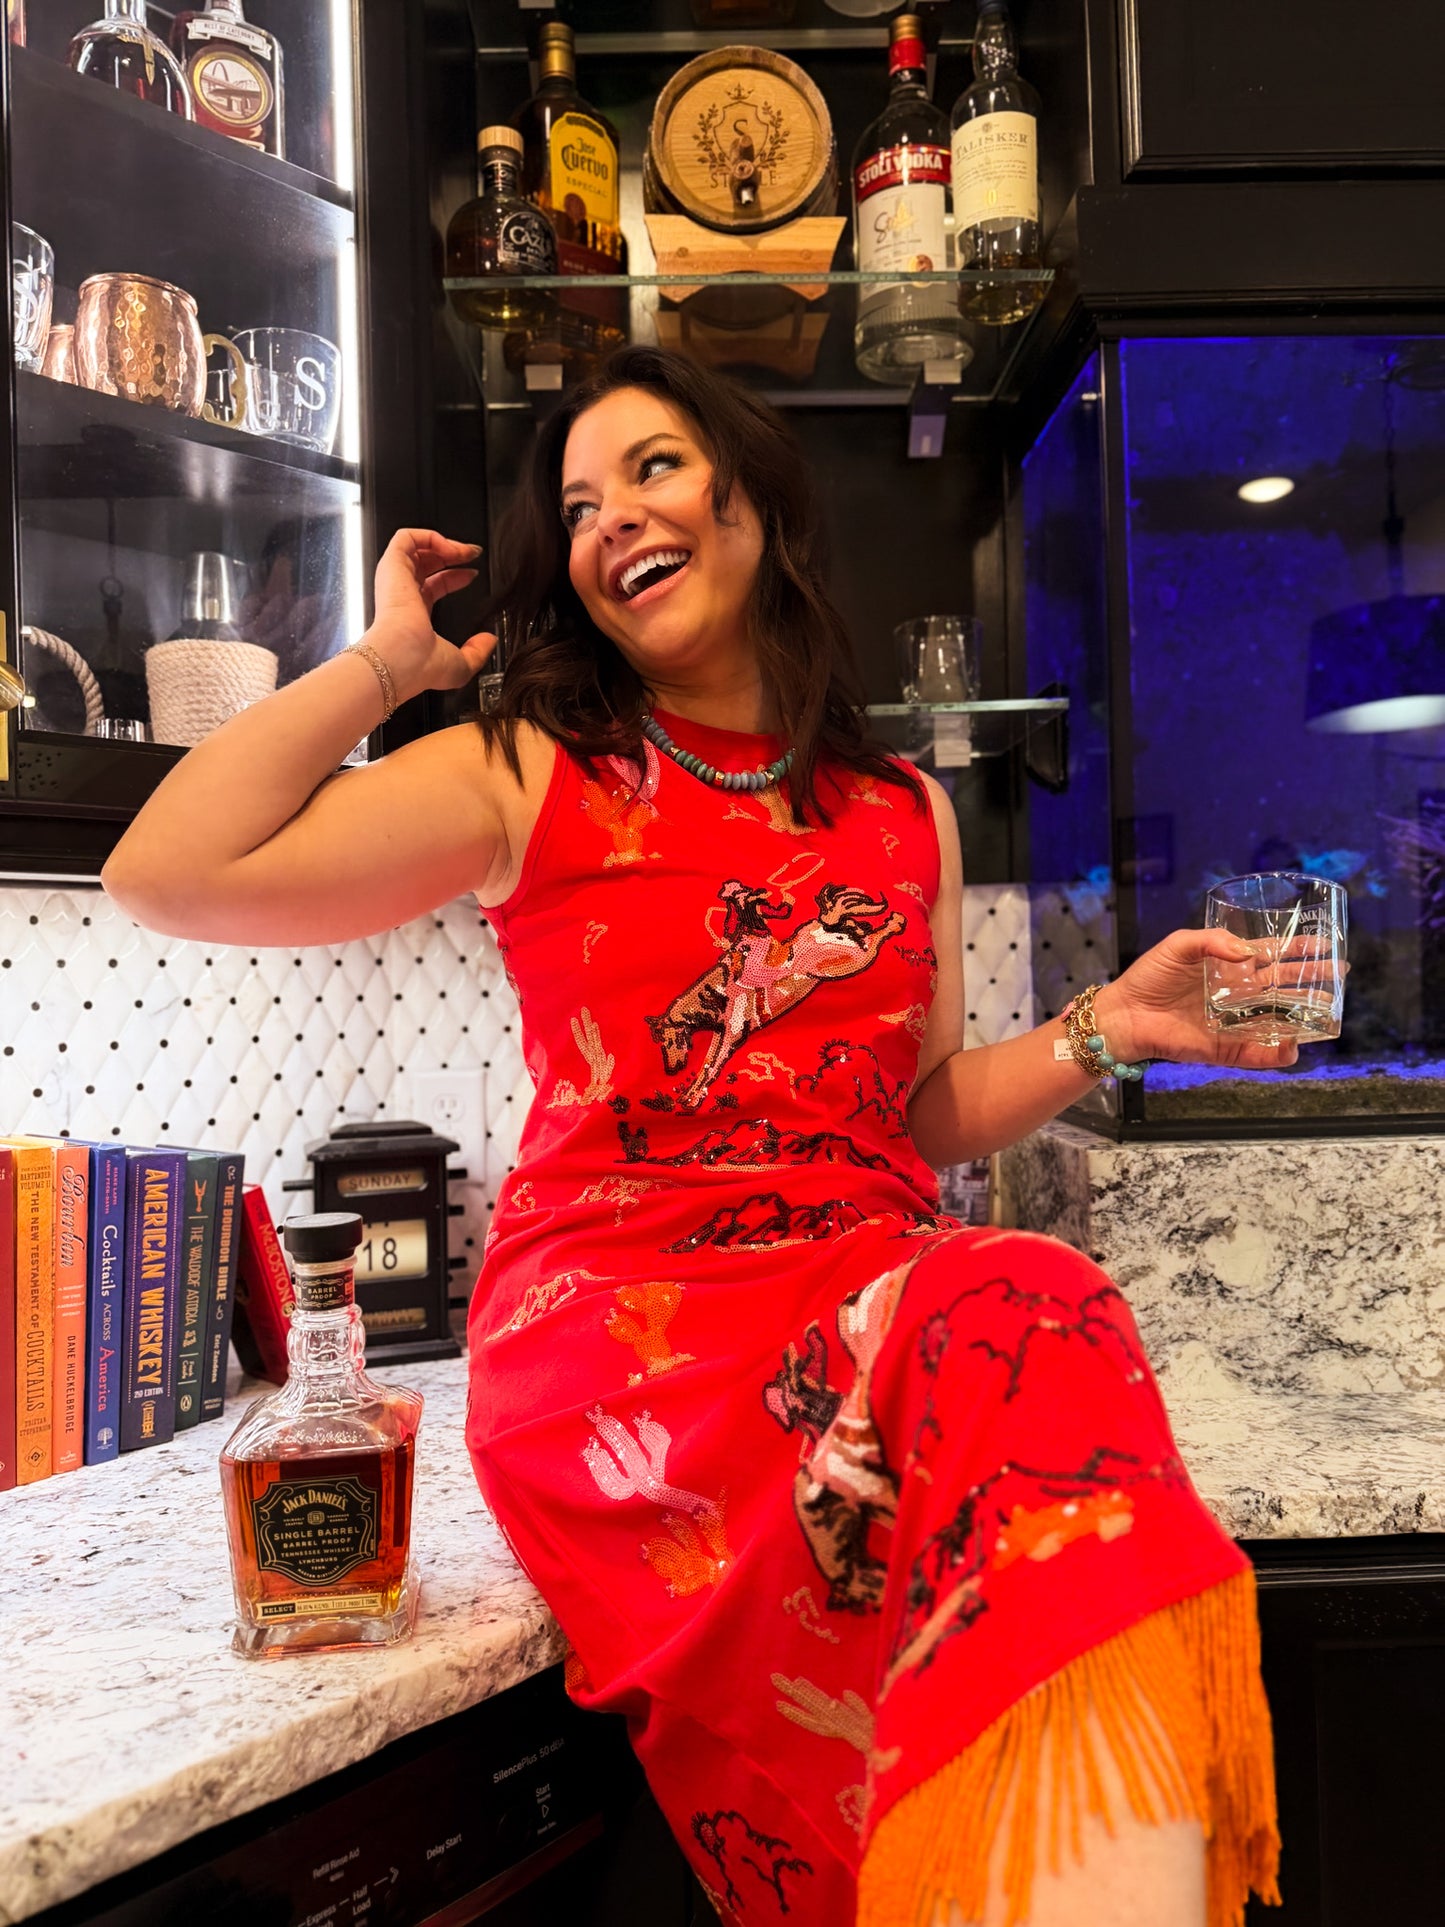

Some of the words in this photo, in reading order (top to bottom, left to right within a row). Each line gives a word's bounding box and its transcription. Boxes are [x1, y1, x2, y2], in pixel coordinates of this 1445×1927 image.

[955, 132, 1029, 160] TALISKER
[561, 144, 609, 182] Cuervo
[894, 152, 944, 171] VODKA
[566, 176, 610, 199] ESPECIAL
[294, 356, 327, 411] S
[1298, 909, 1319, 924] JACK
[349, 1174, 411, 1190] SUNDAY
[30, 1191, 40, 1214] THE
[223, 1184, 236, 1207] THE
[60, 1164, 86, 1268] Bourbon
[140, 1168, 170, 1280] AMERICAN
[30, 1217, 40, 1242] NEW
[190, 1226, 205, 1243] THE
[218, 1208, 234, 1264] BOURBON
[101, 1224, 118, 1297] Cocktails
[186, 1245, 203, 1289] WALDORF
[362, 1238, 398, 1272] 18
[30, 1246, 40, 1312] TESTAMENT
[216, 1265, 229, 1302] BIBLE
[266, 1241, 293, 1304] BOSTON
[307, 1286, 338, 1295] BARREL
[184, 1289, 200, 1328] ASTORIA
[30, 1315, 40, 1329] OF
[102, 1302, 112, 1341] ACROSS
[66, 1335, 77, 1359] DANE
[136, 1286, 165, 1386] WHISKEY
[26, 1330, 45, 1412] COCKTAILS
[98, 1346, 116, 1412] America
[65, 1362, 77, 1434] HUCKELBRIDGE
[282, 1493, 308, 1514] JACK
[308, 1489, 349, 1511] DANIEL'S
[273, 1530, 314, 1541] SINGLE
[317, 1526, 361, 1537] BARREL
[282, 1540, 319, 1549] BARREL
[321, 1537, 352, 1545] PROOF
[280, 1549, 321, 1558] TENNESSEE
[323, 1546, 355, 1554] WHISKEY
[298, 1556, 338, 1565] LYNCHBURG
[263, 1604, 295, 1615] SELECT
[493, 1753, 538, 1784] SilencePlus
[539, 1745, 550, 1759] 50
[535, 1783, 551, 1797] Start
[426, 1842, 445, 1861] Delay
[445, 1832, 463, 1850] Start
[352, 1884, 368, 1901] Half
[306, 1904, 337, 1927] Express
[352, 1897, 372, 1916] Load
